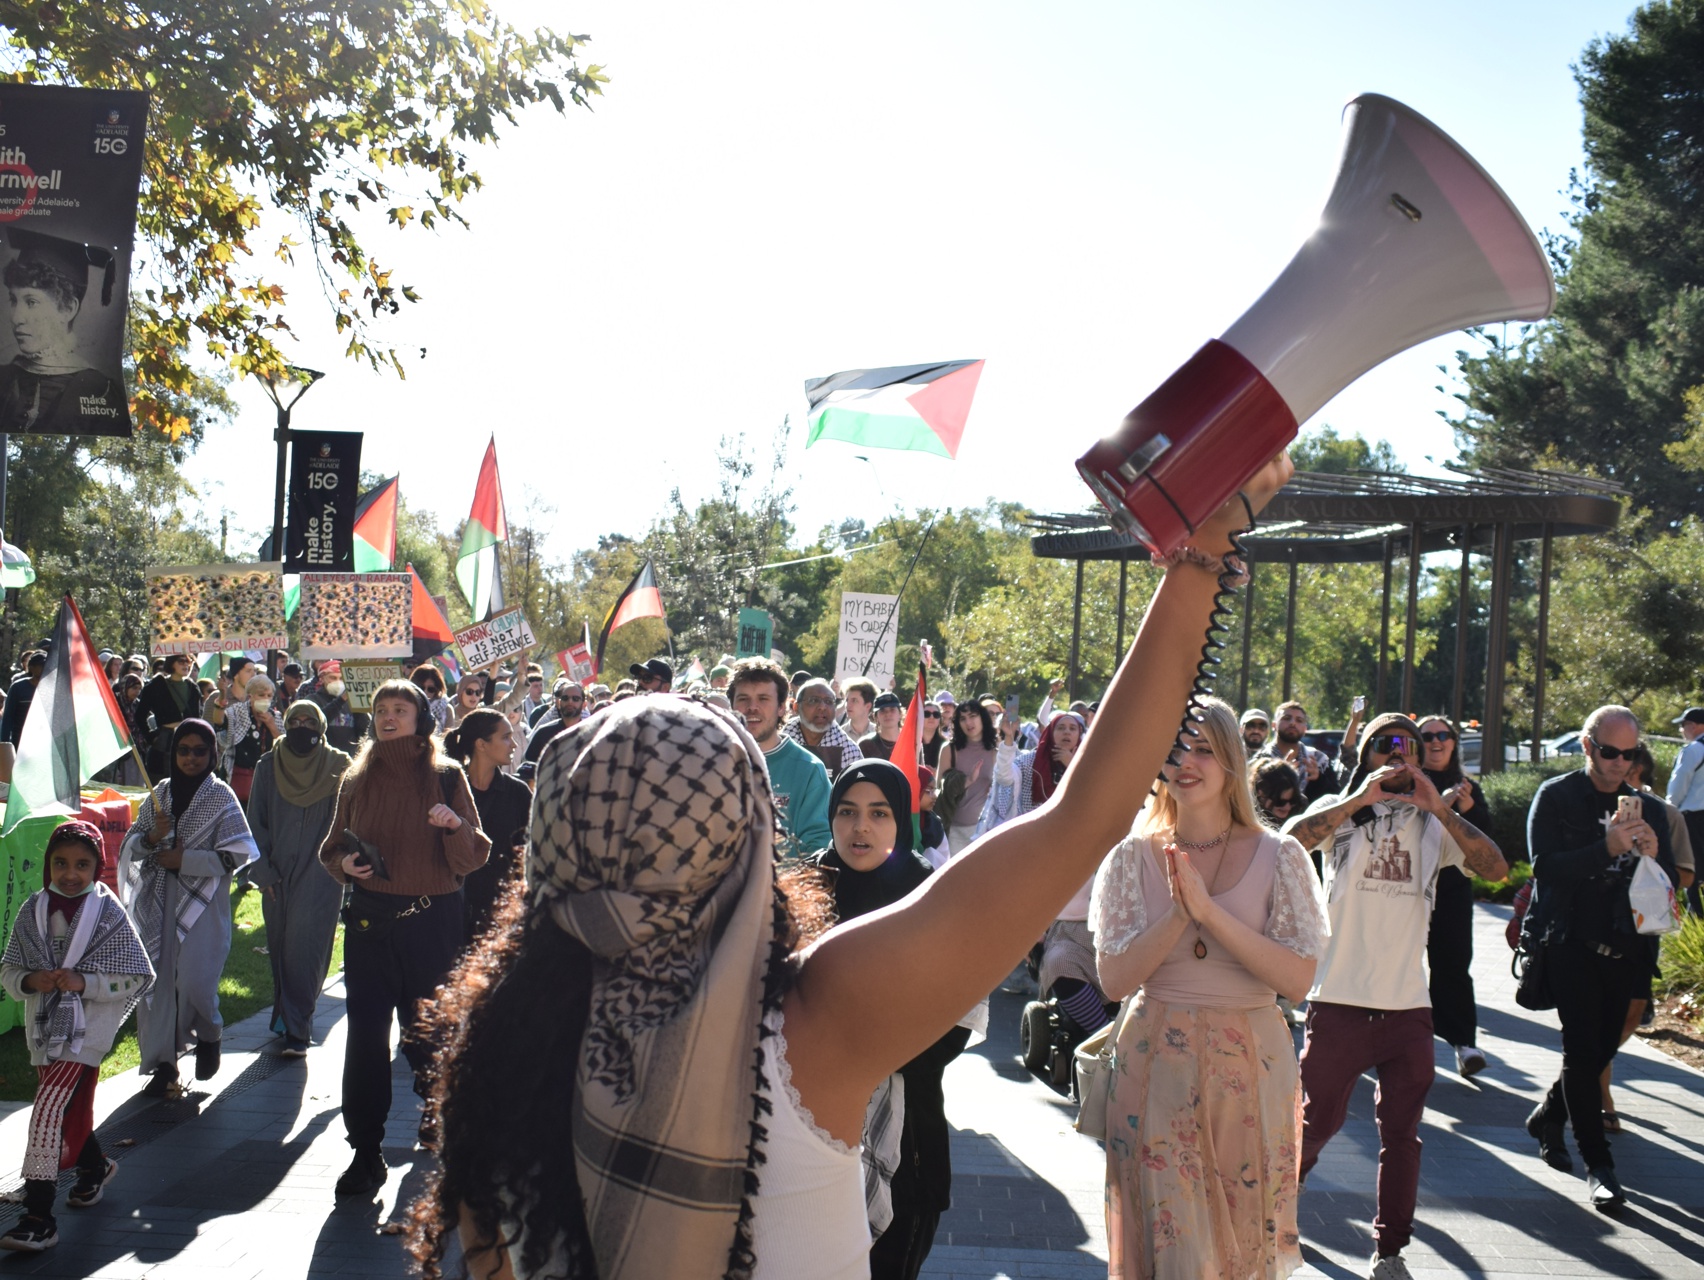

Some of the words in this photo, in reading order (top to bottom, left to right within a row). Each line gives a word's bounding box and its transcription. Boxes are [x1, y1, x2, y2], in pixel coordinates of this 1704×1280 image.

[27, 196, 36, 205] of
[37, 197, 80, 207] Adelaide's
[15, 206, 52, 217] graduate
[80, 394, 107, 405] make
[80, 404, 119, 418] history.
[1284, 500, 1395, 518] KAURNA
[304, 517, 319, 563] make
[318, 501, 337, 564] history.
[304, 574, 320, 582] ALL
[322, 574, 346, 582] EYES
[349, 573, 361, 582] ON
[366, 574, 401, 582] RAFAH
[845, 600, 864, 618] MY
[457, 623, 493, 648] BOMBING
[491, 611, 526, 634] CHILDREN
[845, 621, 857, 634] IS
[861, 620, 896, 635] OLDER
[153, 644, 182, 655] ALL
[188, 641, 220, 654] EYES
[225, 639, 243, 651] ON
[248, 636, 287, 649] RAFAH
[475, 641, 487, 653] IS
[490, 628, 513, 646] NOT
[853, 638, 888, 654] THAN
[345, 667, 354, 680] IS
[356, 667, 397, 680] GENOCIDE
[844, 656, 891, 677] ISRAEL
[345, 681, 369, 692] JUST
